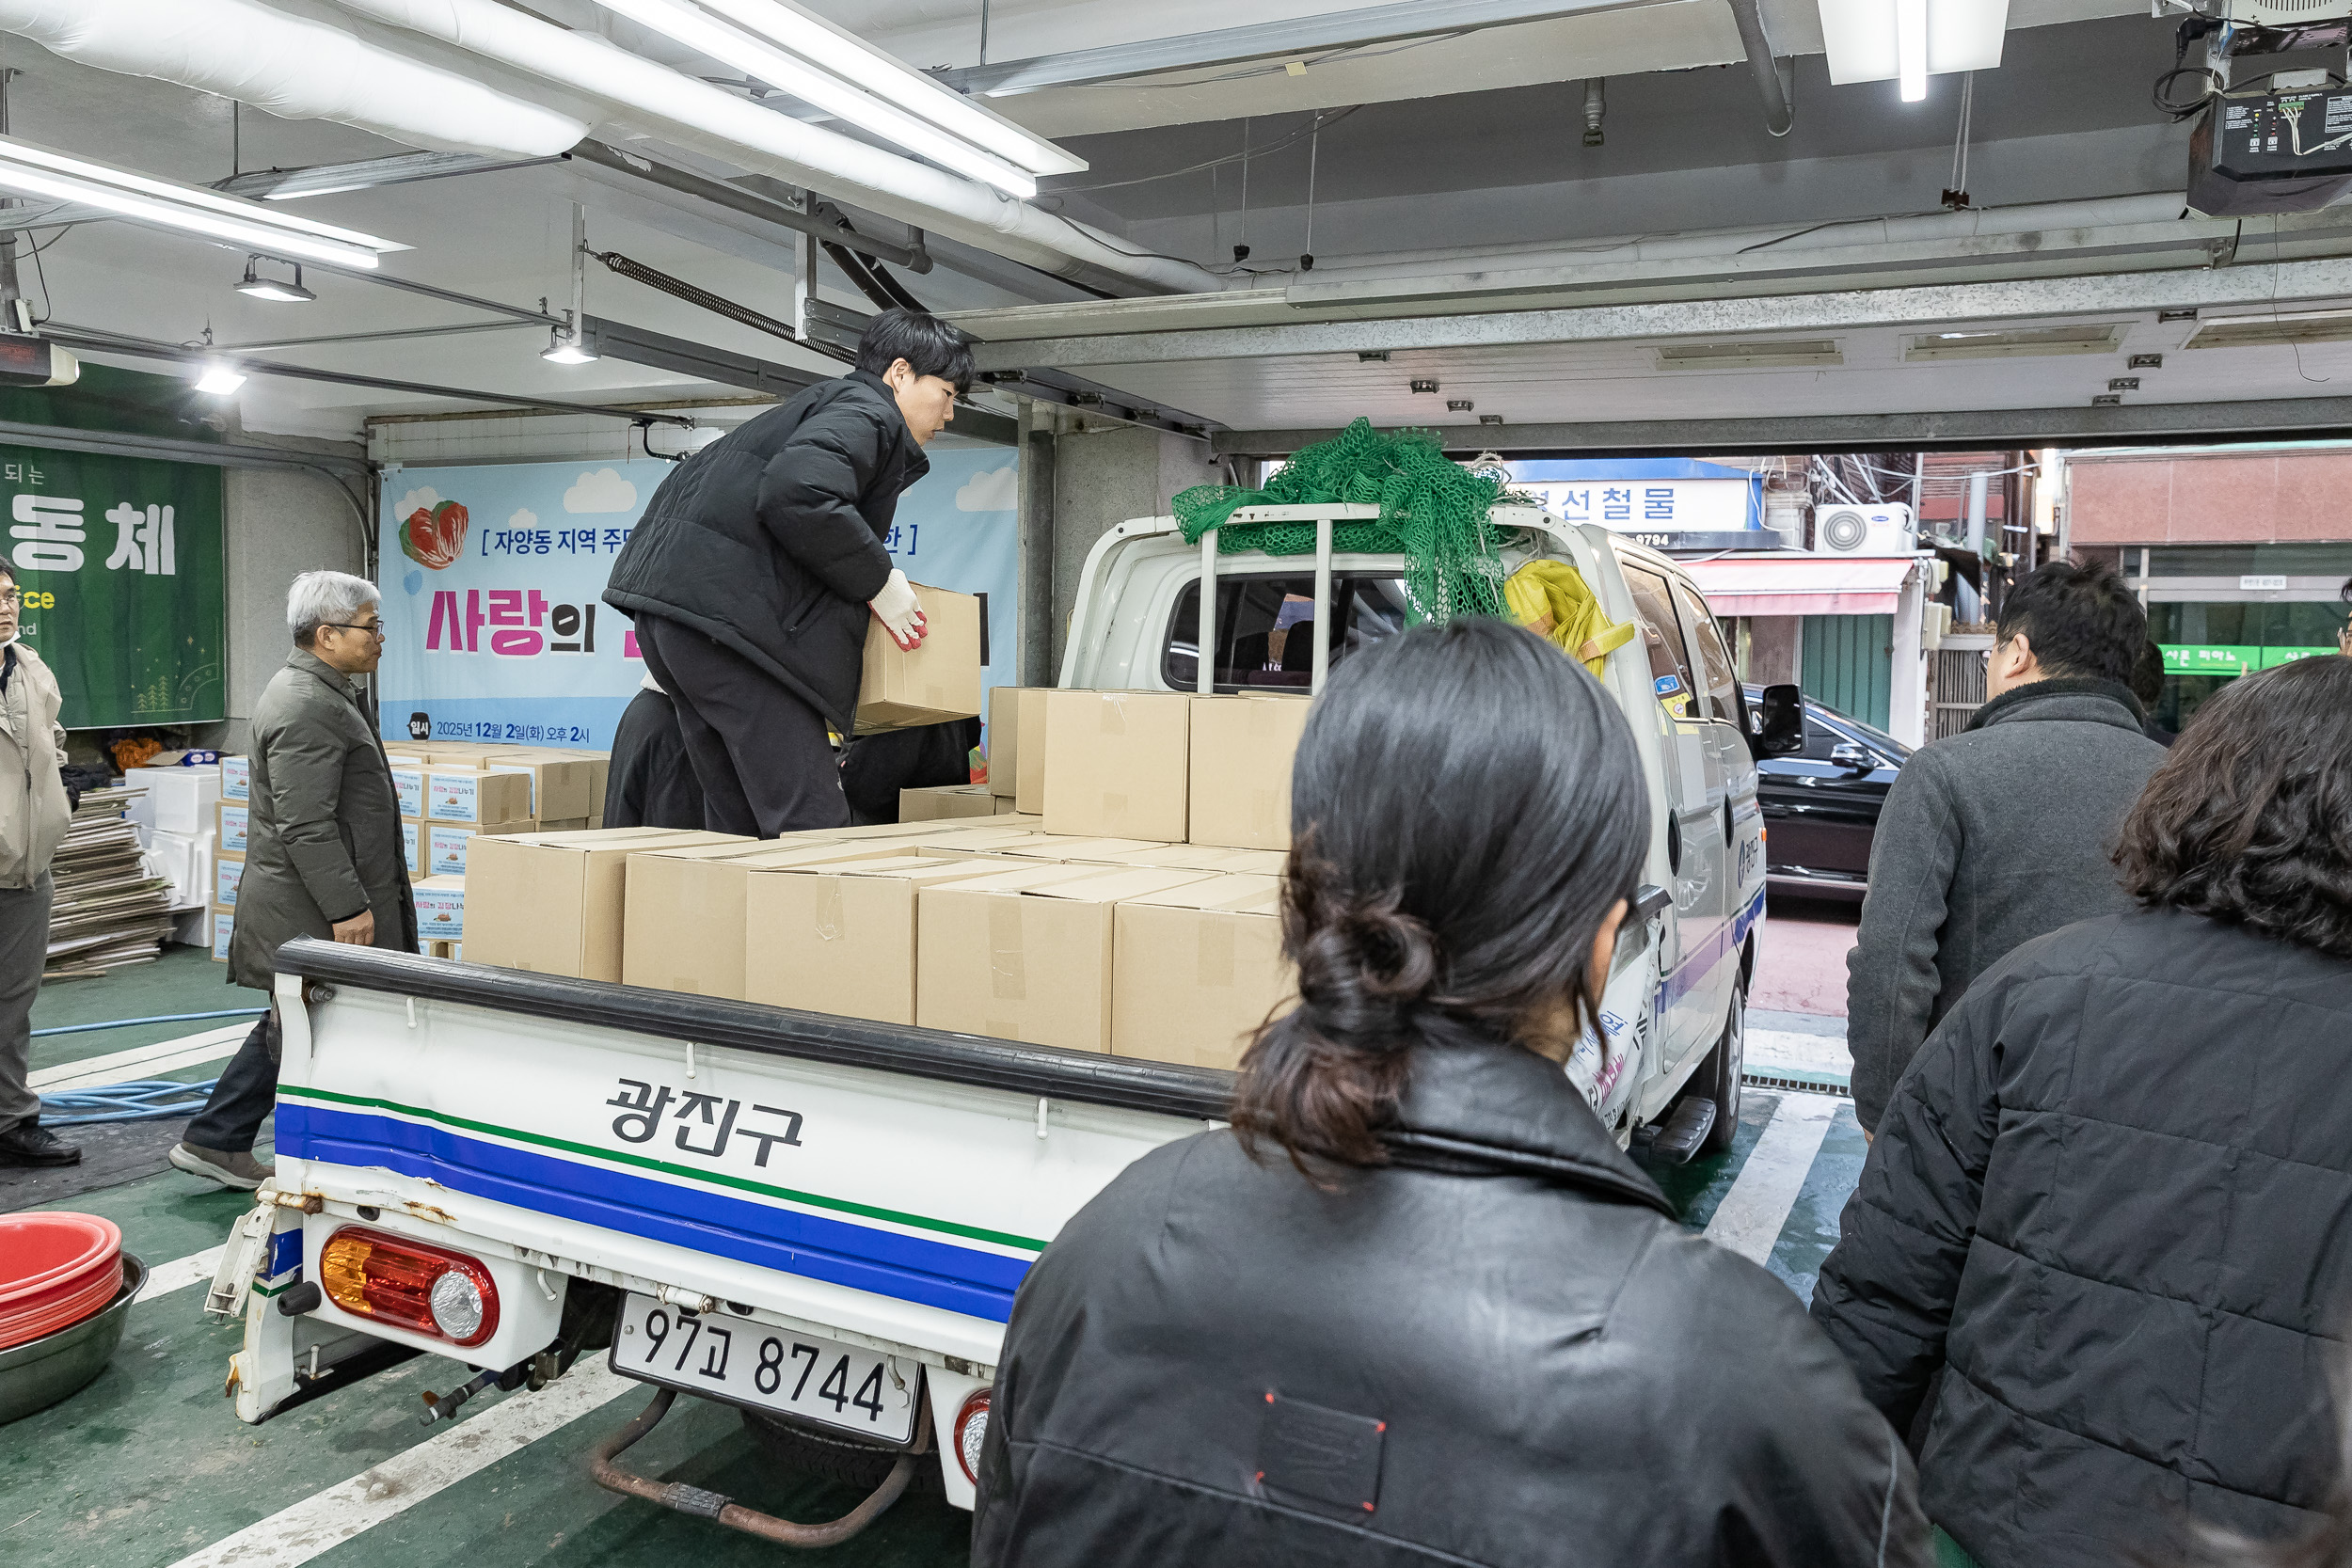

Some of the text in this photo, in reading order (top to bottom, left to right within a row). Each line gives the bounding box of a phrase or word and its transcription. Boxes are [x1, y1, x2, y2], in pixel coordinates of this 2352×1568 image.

[4, 464, 45, 485] 되는
[9, 494, 176, 576] 동체
[494, 529, 552, 555] 자양동
[557, 528, 596, 554] 지역
[426, 589, 596, 656] 사랑의
[410, 721, 429, 736] 일시
[437, 721, 590, 743] 2025년 12월 2일(화) 오후 2시
[605, 1078, 803, 1168] 광진구
[645, 1308, 884, 1421] 97고 8744
